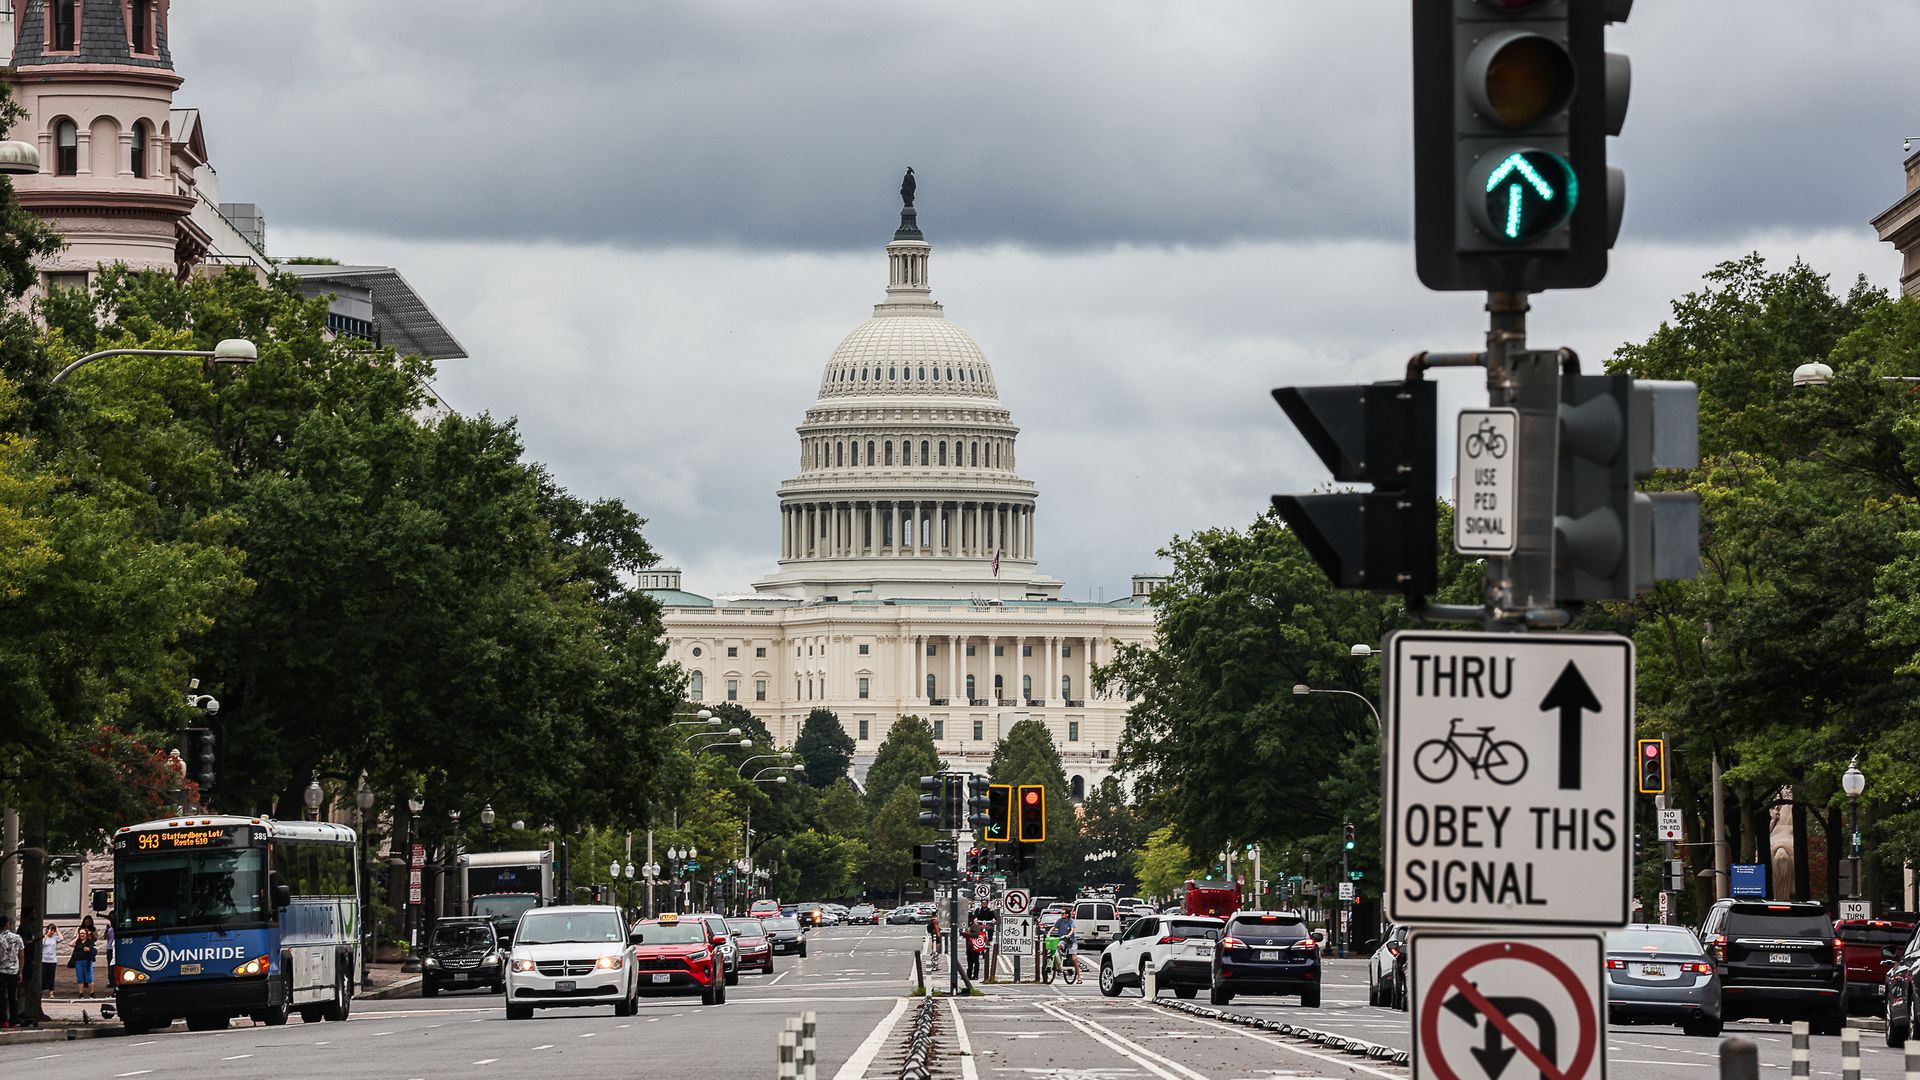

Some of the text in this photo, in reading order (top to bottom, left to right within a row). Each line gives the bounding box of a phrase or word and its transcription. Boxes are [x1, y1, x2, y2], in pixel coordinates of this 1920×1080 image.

[1475, 468, 1497, 486] USE
[1474, 492, 1497, 511] PED
[1465, 516, 1506, 535] SIGNAL
[1410, 655, 1514, 699] THRU
[253, 832, 267, 840] 385
[1405, 803, 1616, 851] OBEY THIS
[138, 834, 159, 849] 943
[174, 837, 208, 846] Route 610
[1403, 859, 1547, 905] SIGNAL
